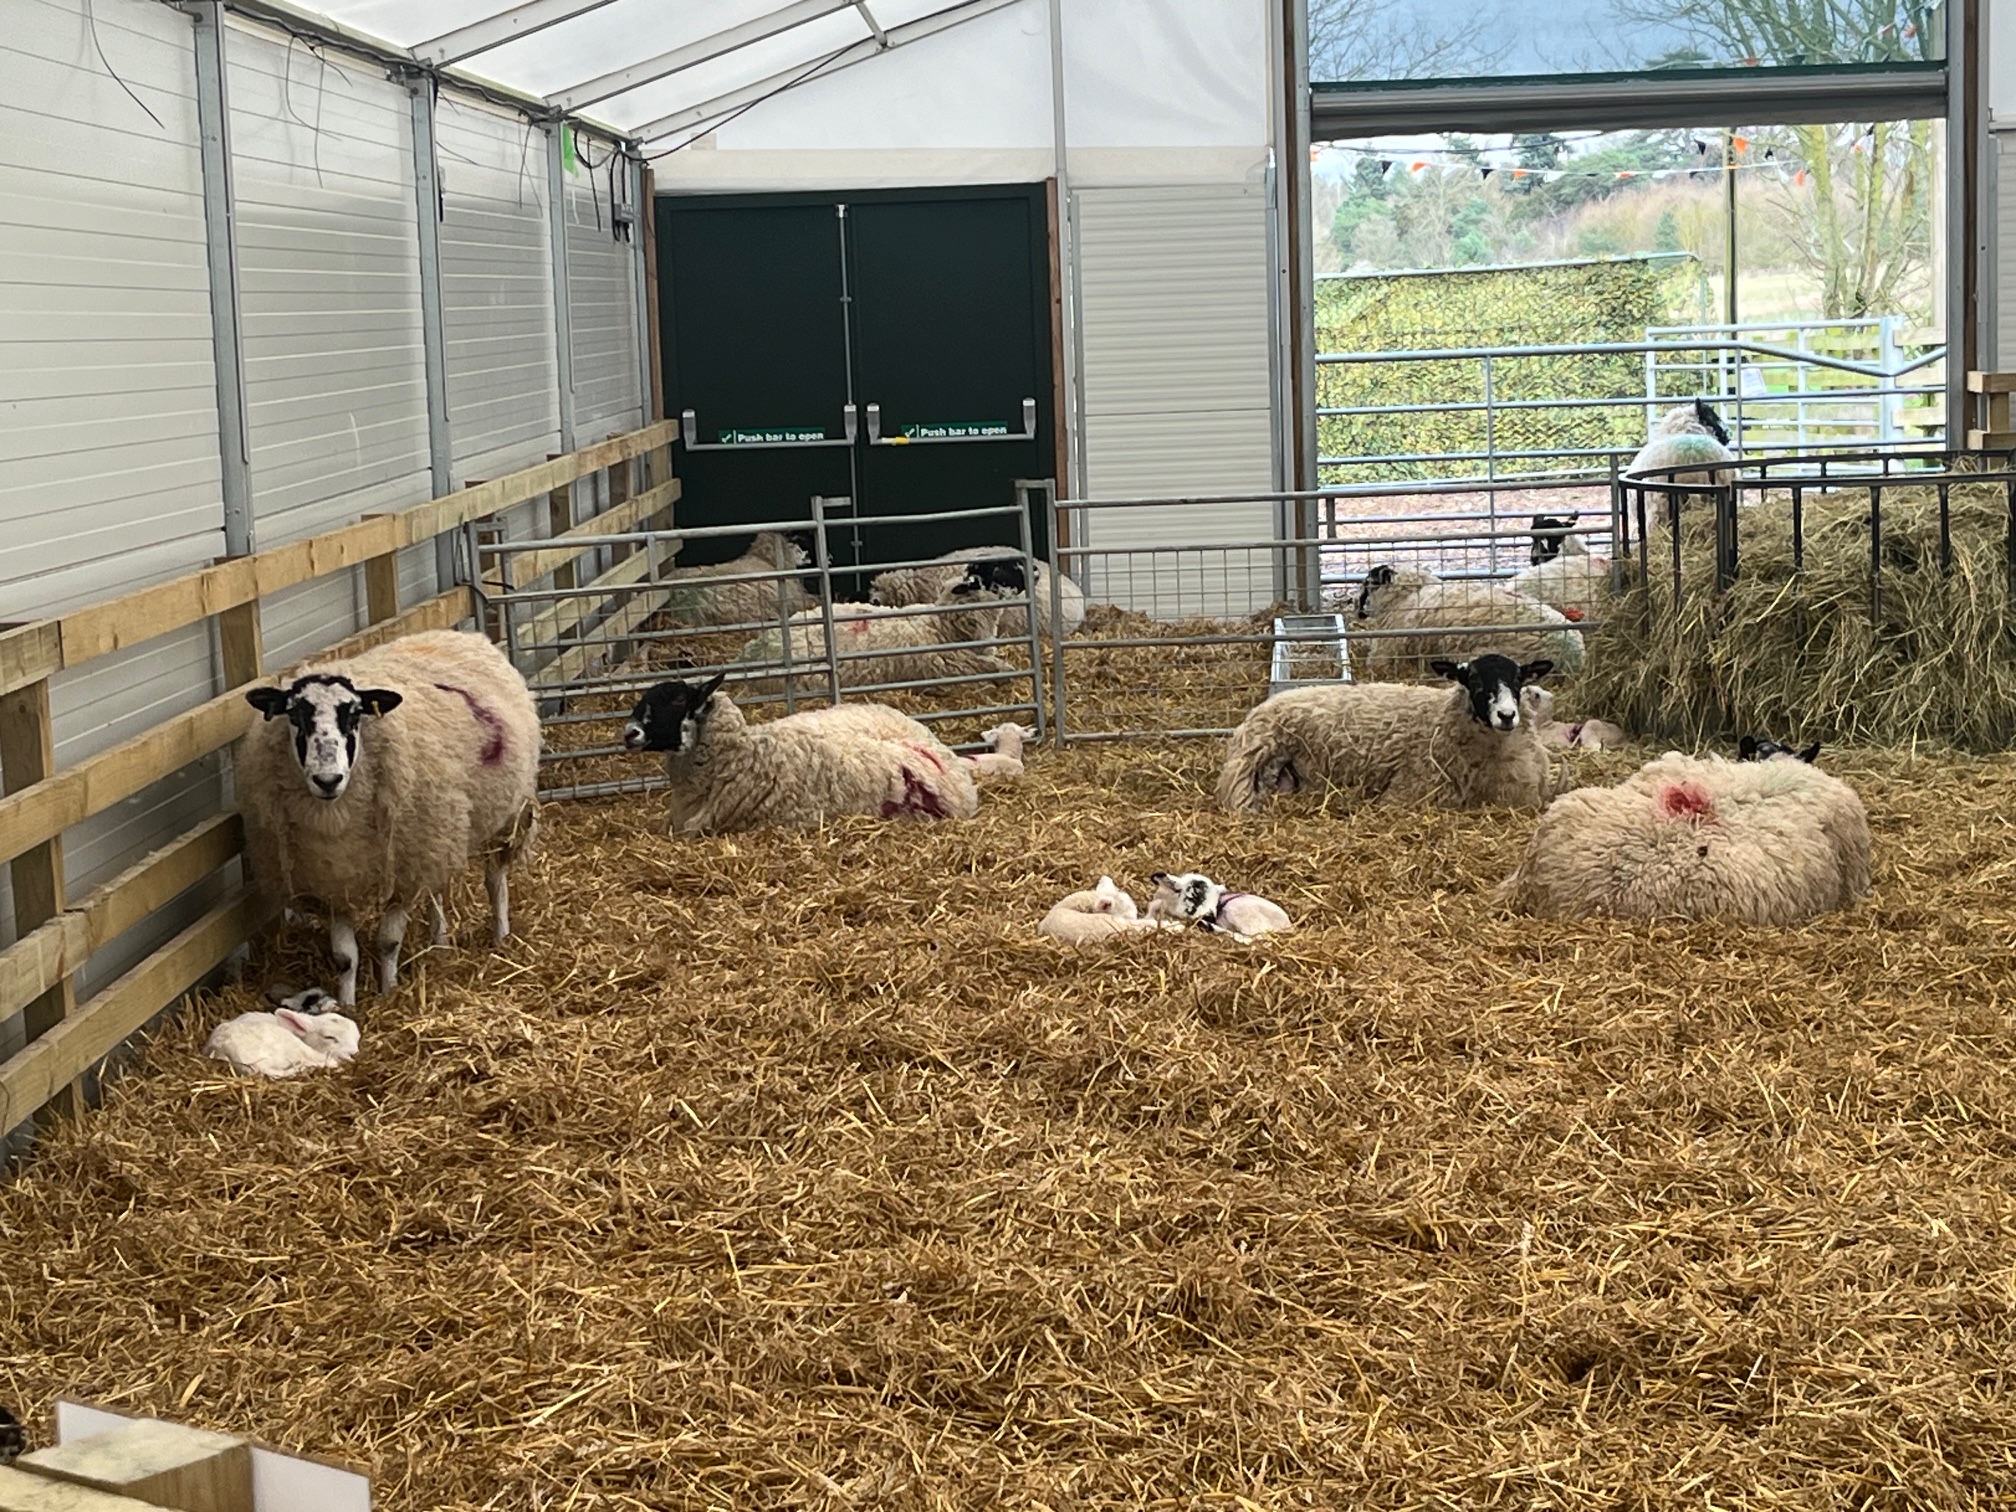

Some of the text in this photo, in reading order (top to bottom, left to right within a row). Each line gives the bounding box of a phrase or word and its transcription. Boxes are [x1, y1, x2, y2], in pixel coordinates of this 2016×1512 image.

[738, 431, 824, 442] Push bar to open
[920, 426, 1007, 437] Push bar to open
